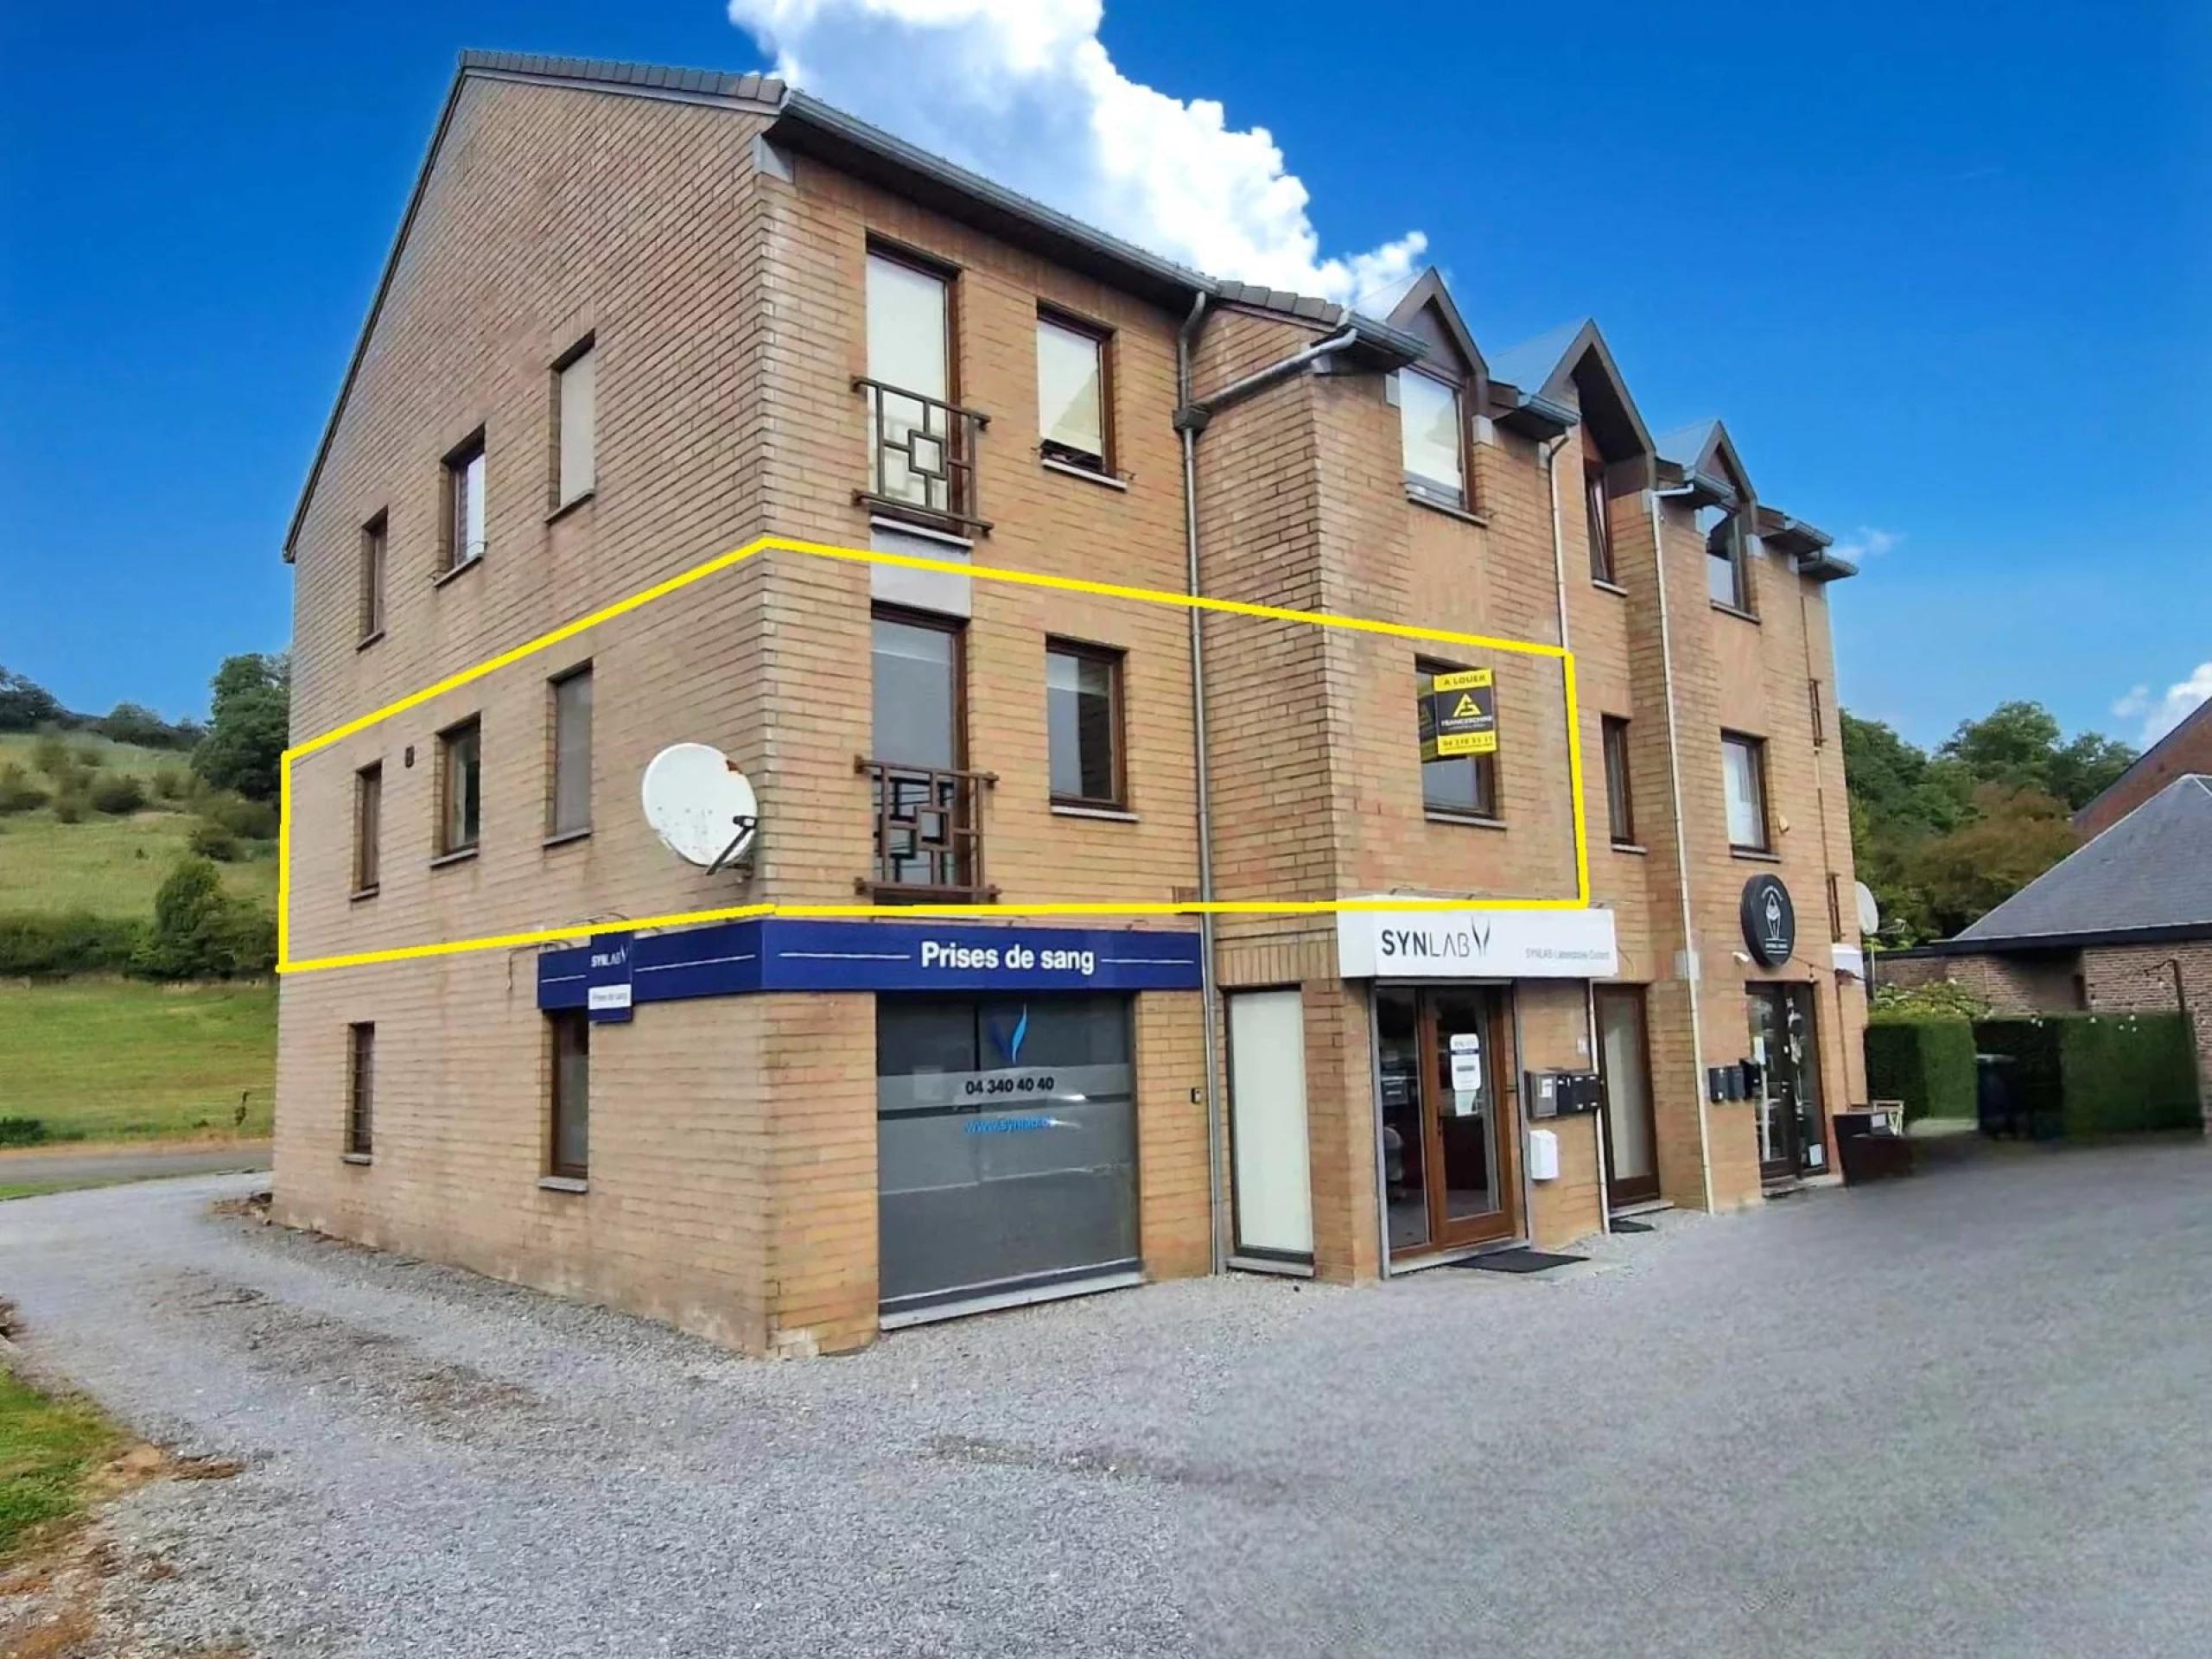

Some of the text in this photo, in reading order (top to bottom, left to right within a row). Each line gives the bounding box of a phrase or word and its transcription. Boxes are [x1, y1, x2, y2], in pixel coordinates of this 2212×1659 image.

[1453, 674, 1486, 685] LOUER
[1382, 929, 1470, 958] SYNLAB
[921, 940, 1095, 976] Prises de sang
[965, 1077, 1055, 1095] 04 340 40 40
